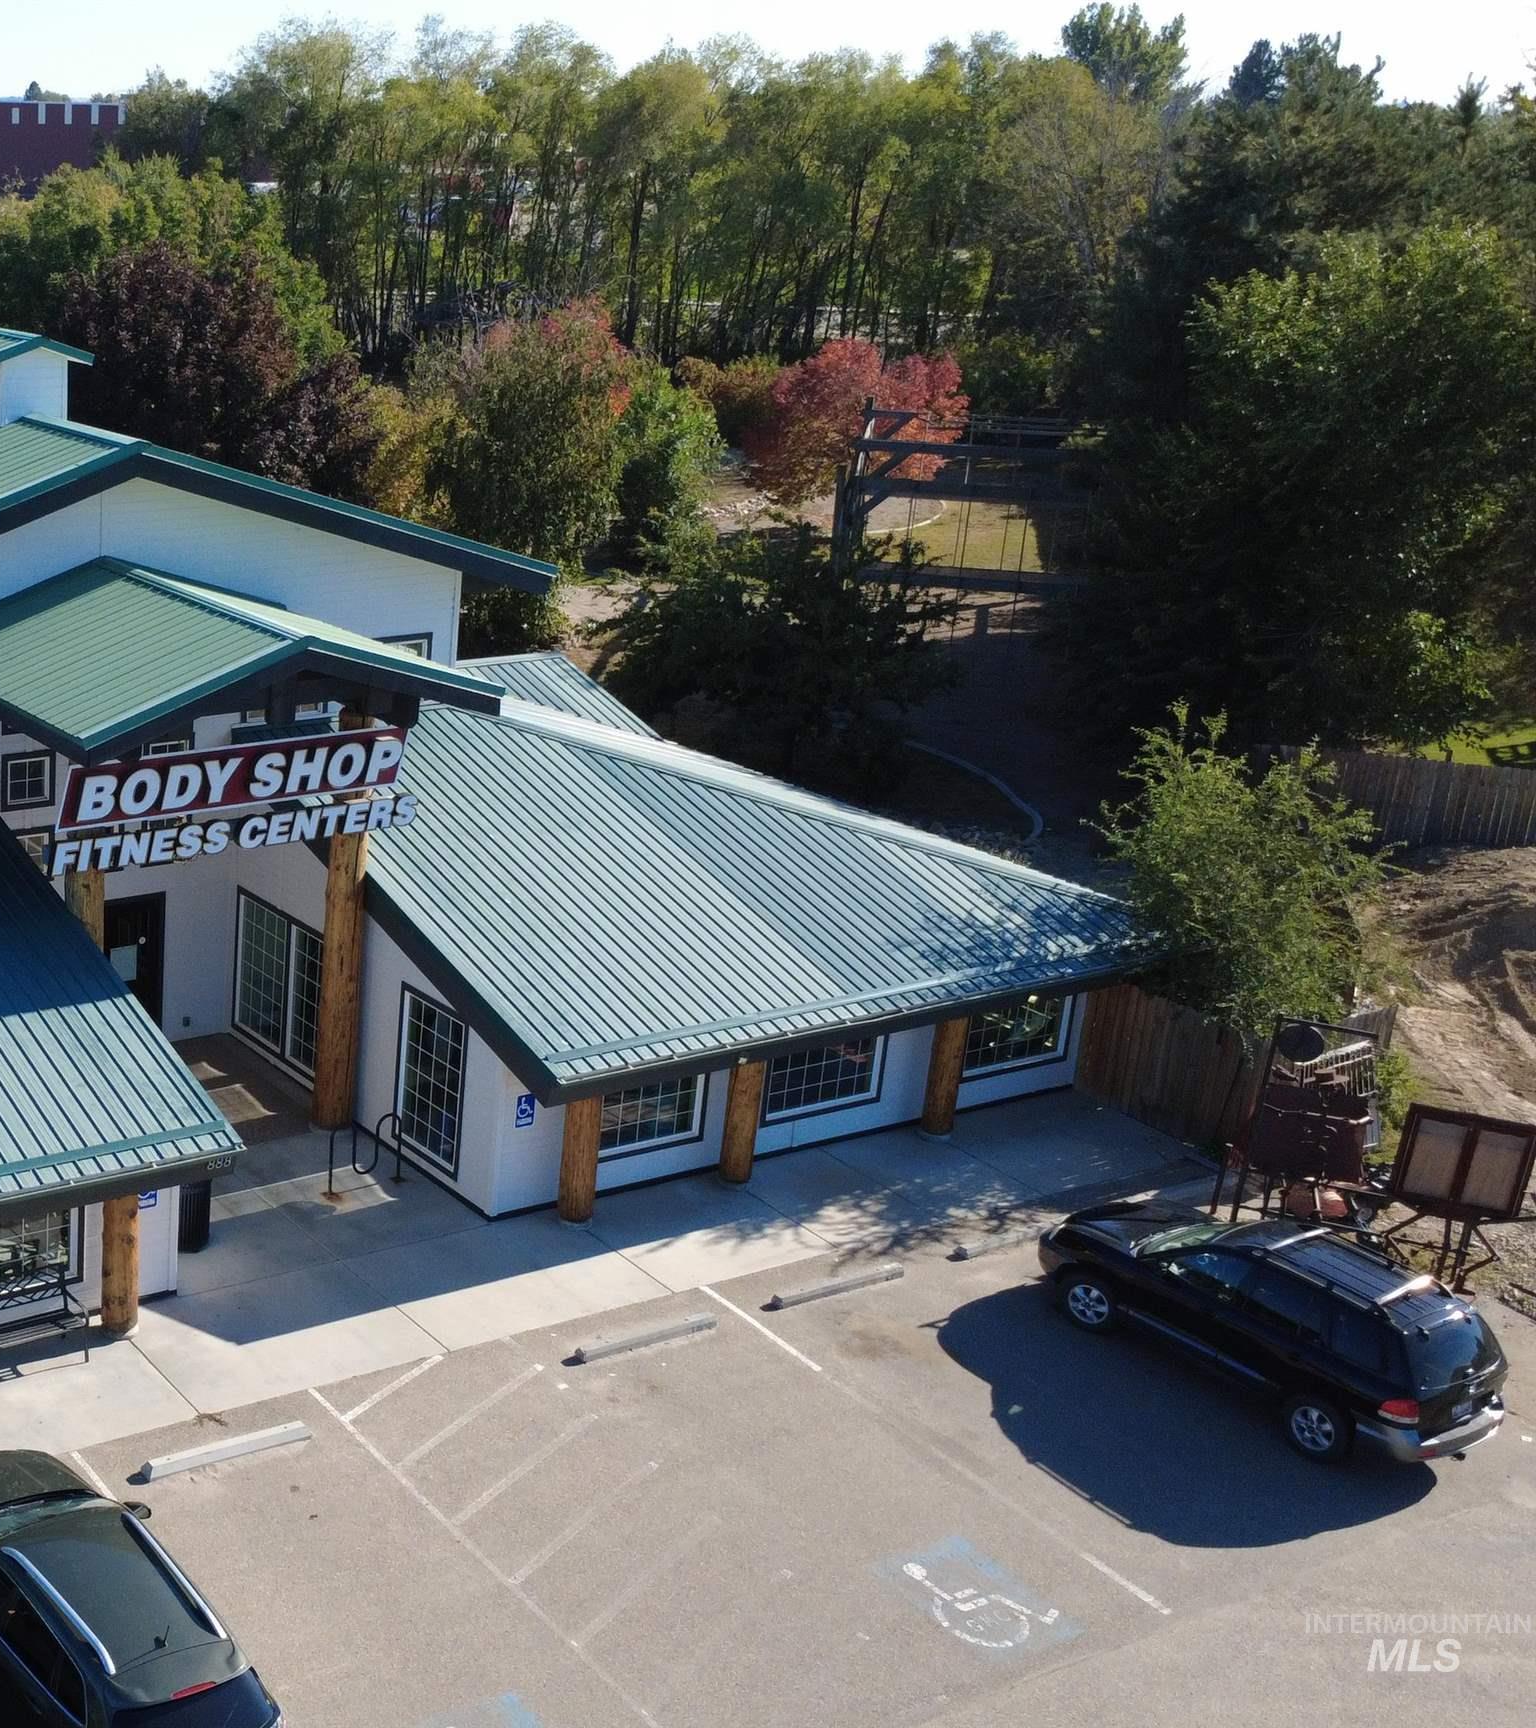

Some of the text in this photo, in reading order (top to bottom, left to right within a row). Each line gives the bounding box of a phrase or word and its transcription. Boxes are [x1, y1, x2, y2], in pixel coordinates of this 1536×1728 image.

[76, 736, 403, 823] BODY SHOP
[51, 792, 419, 877] FITNESS CENTERS
[207, 1155, 232, 1170] 888
